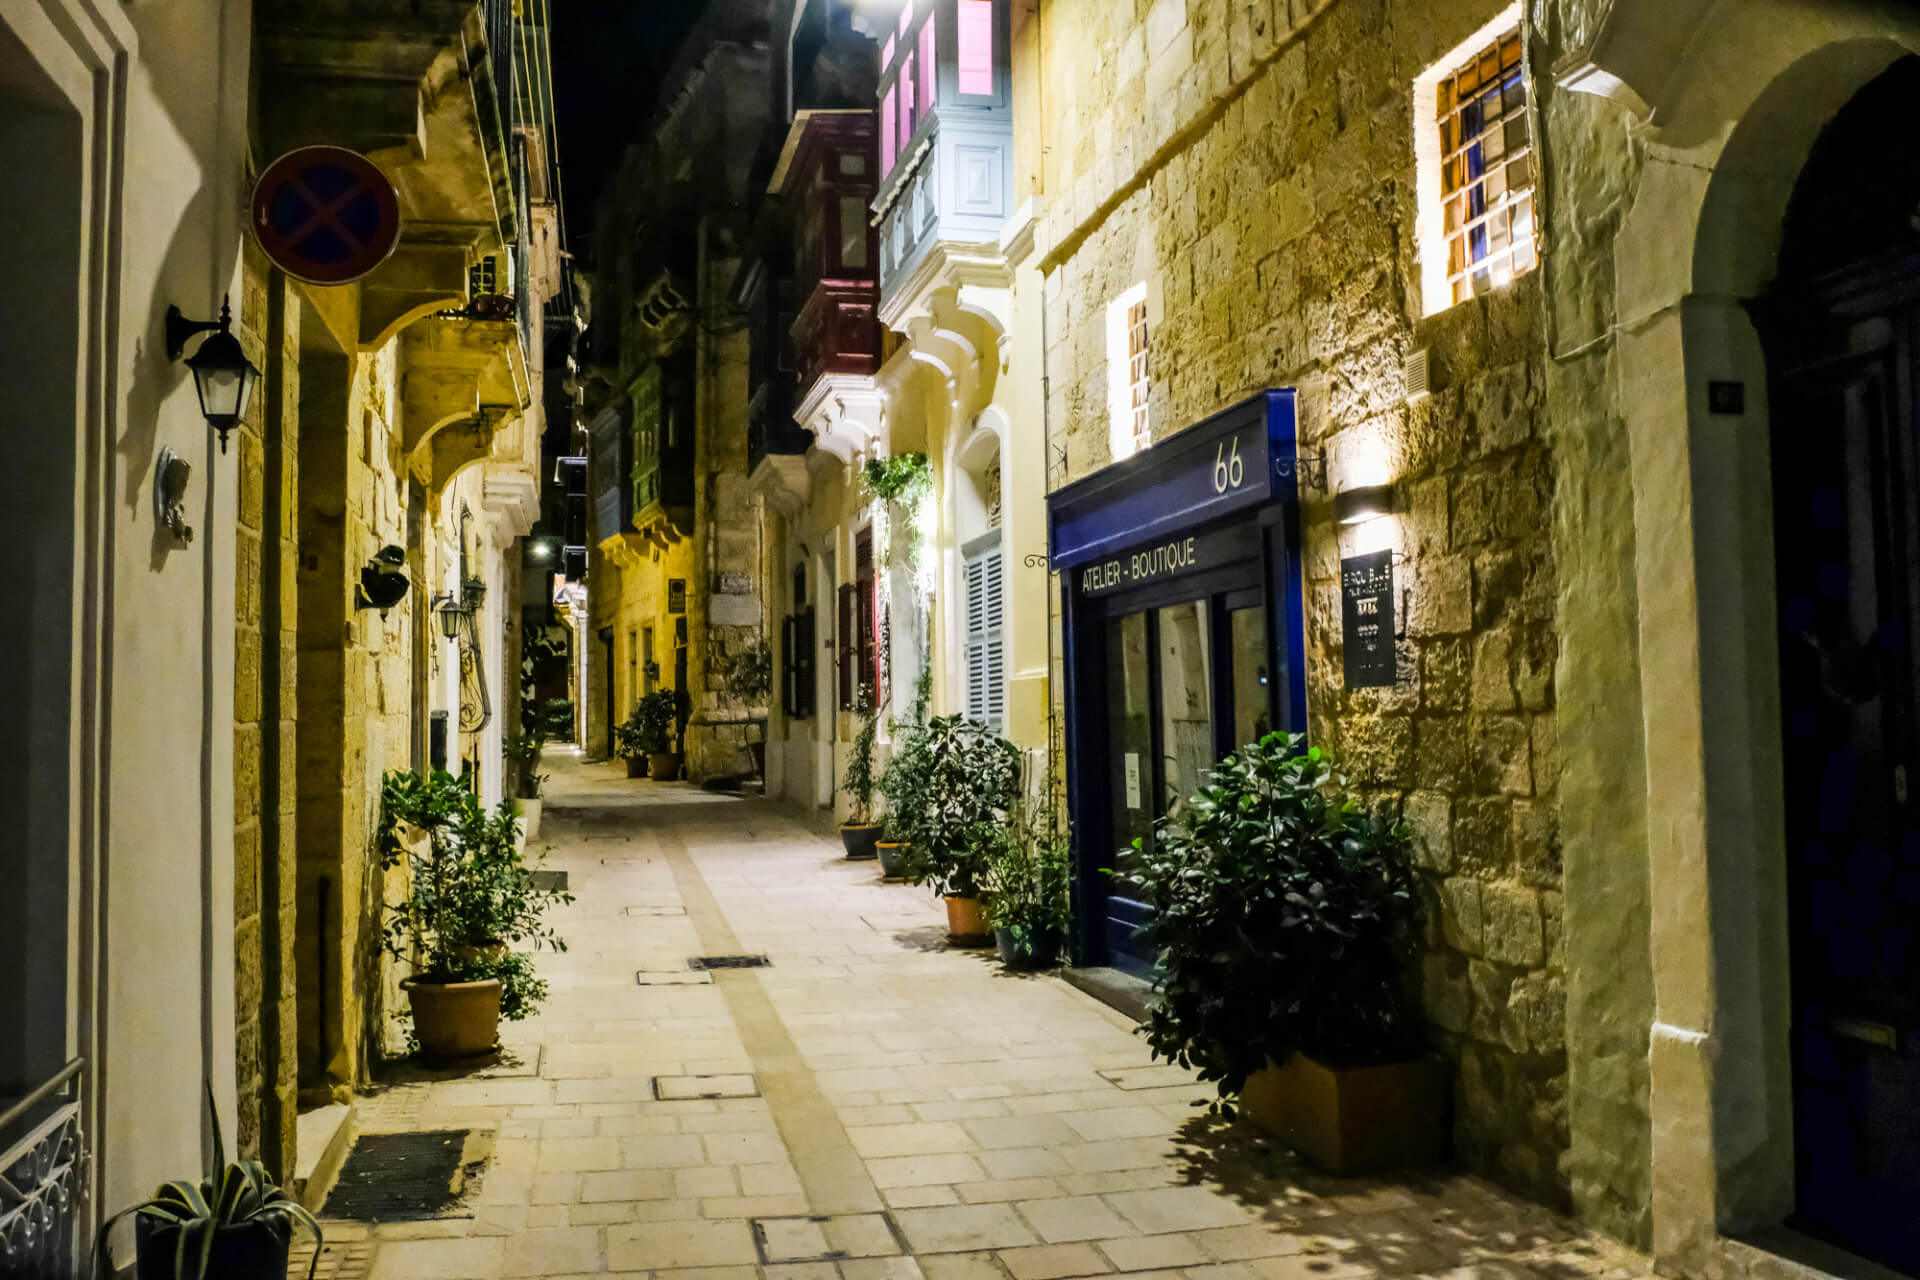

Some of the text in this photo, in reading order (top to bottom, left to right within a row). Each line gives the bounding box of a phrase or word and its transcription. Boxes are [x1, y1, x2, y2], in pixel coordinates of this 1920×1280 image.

[1214, 436, 1243, 493] 66
[1082, 561, 1121, 592] ATELIER
[1132, 537, 1196, 579] BOUTIQUE
